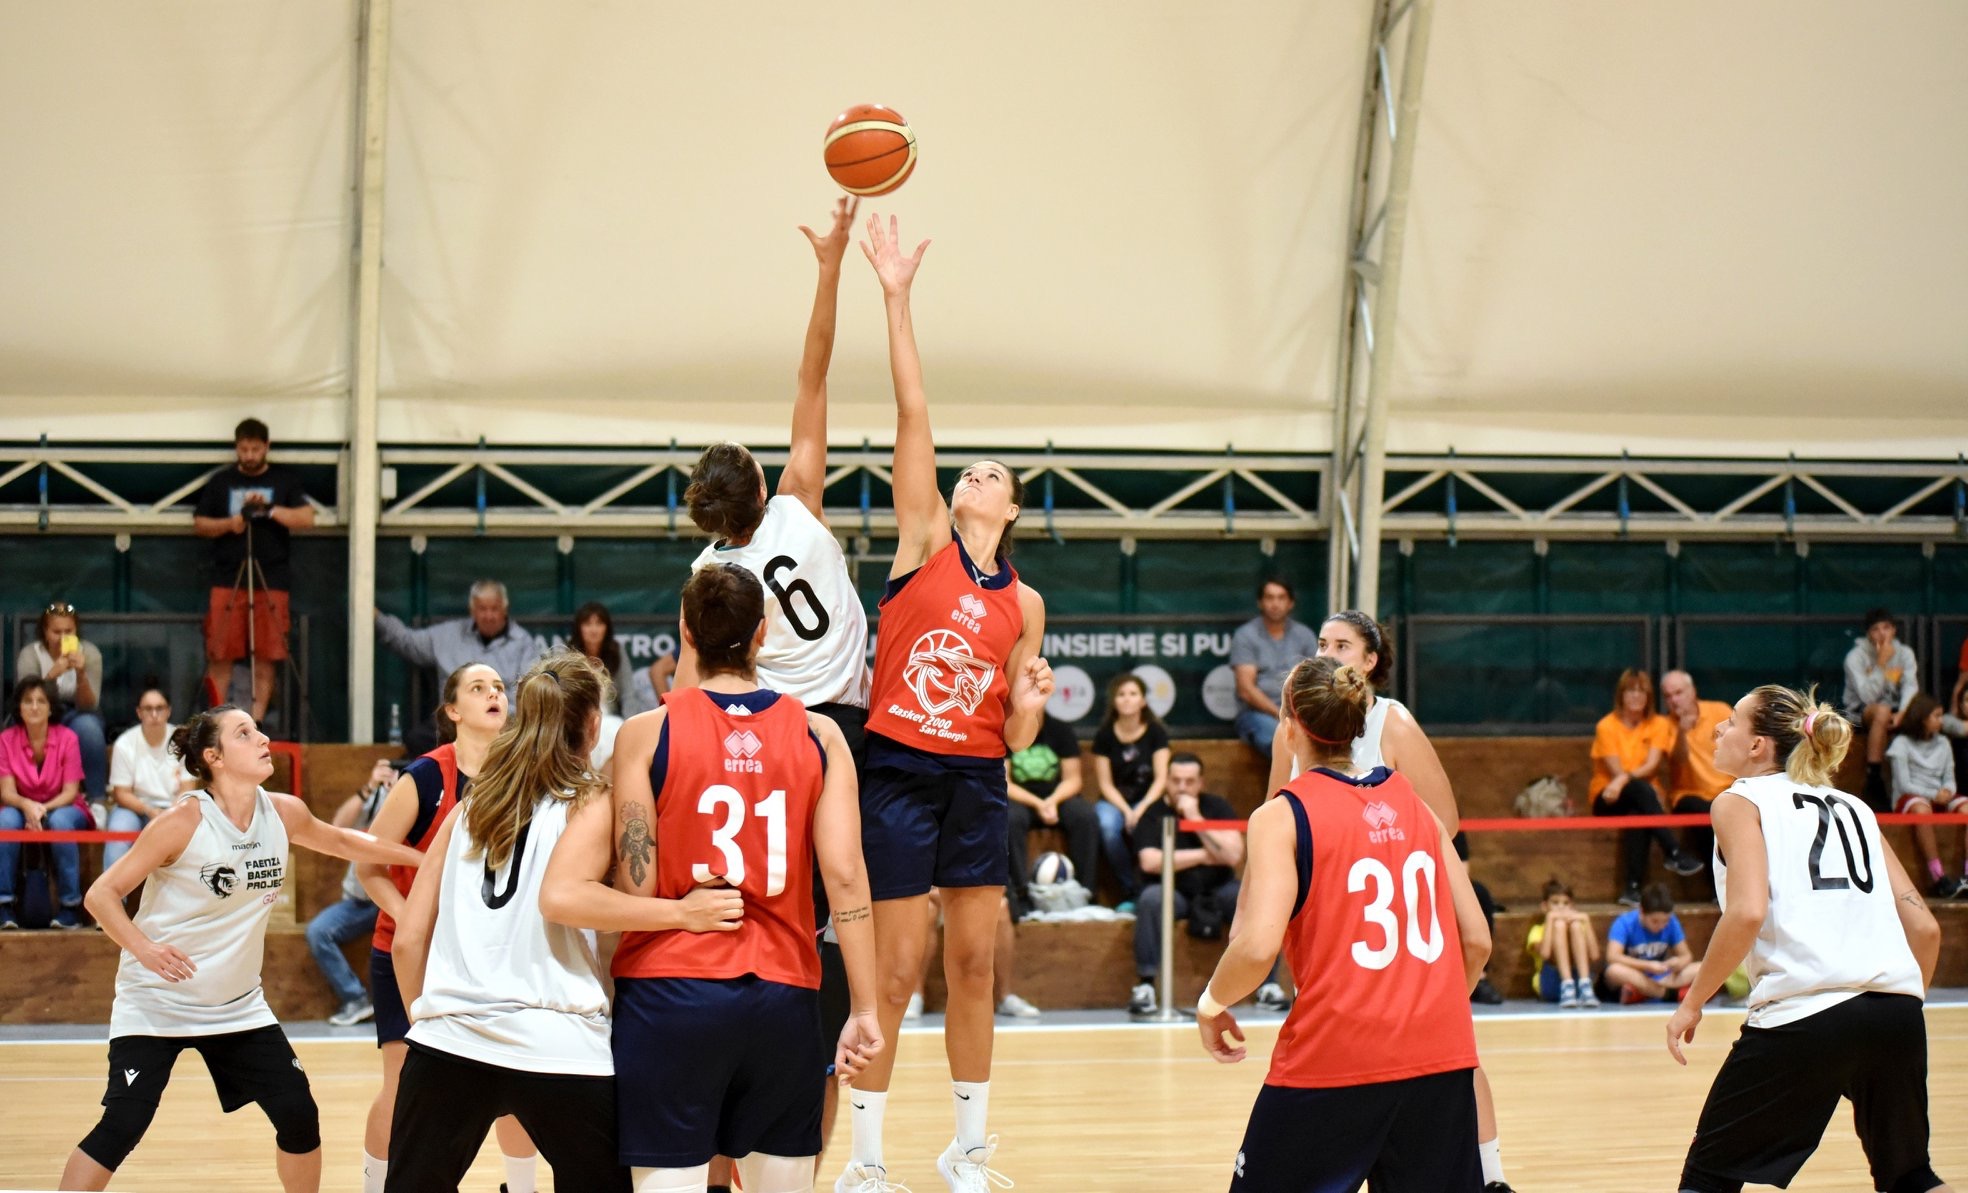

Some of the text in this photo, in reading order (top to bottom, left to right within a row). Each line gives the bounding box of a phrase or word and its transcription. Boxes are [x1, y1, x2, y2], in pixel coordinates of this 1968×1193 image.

[763, 555, 829, 641] 6
[1043, 633, 1231, 657] INSIEME SI PU
[888, 704, 953, 730] Basket 2000
[919, 725, 968, 742] San Giorgio
[692, 784, 787, 897] 31
[1793, 793, 1873, 893] 20
[246, 878, 284, 890] PROJEC
[247, 868, 281, 880] BASKET
[1348, 851, 1444, 970] 30
